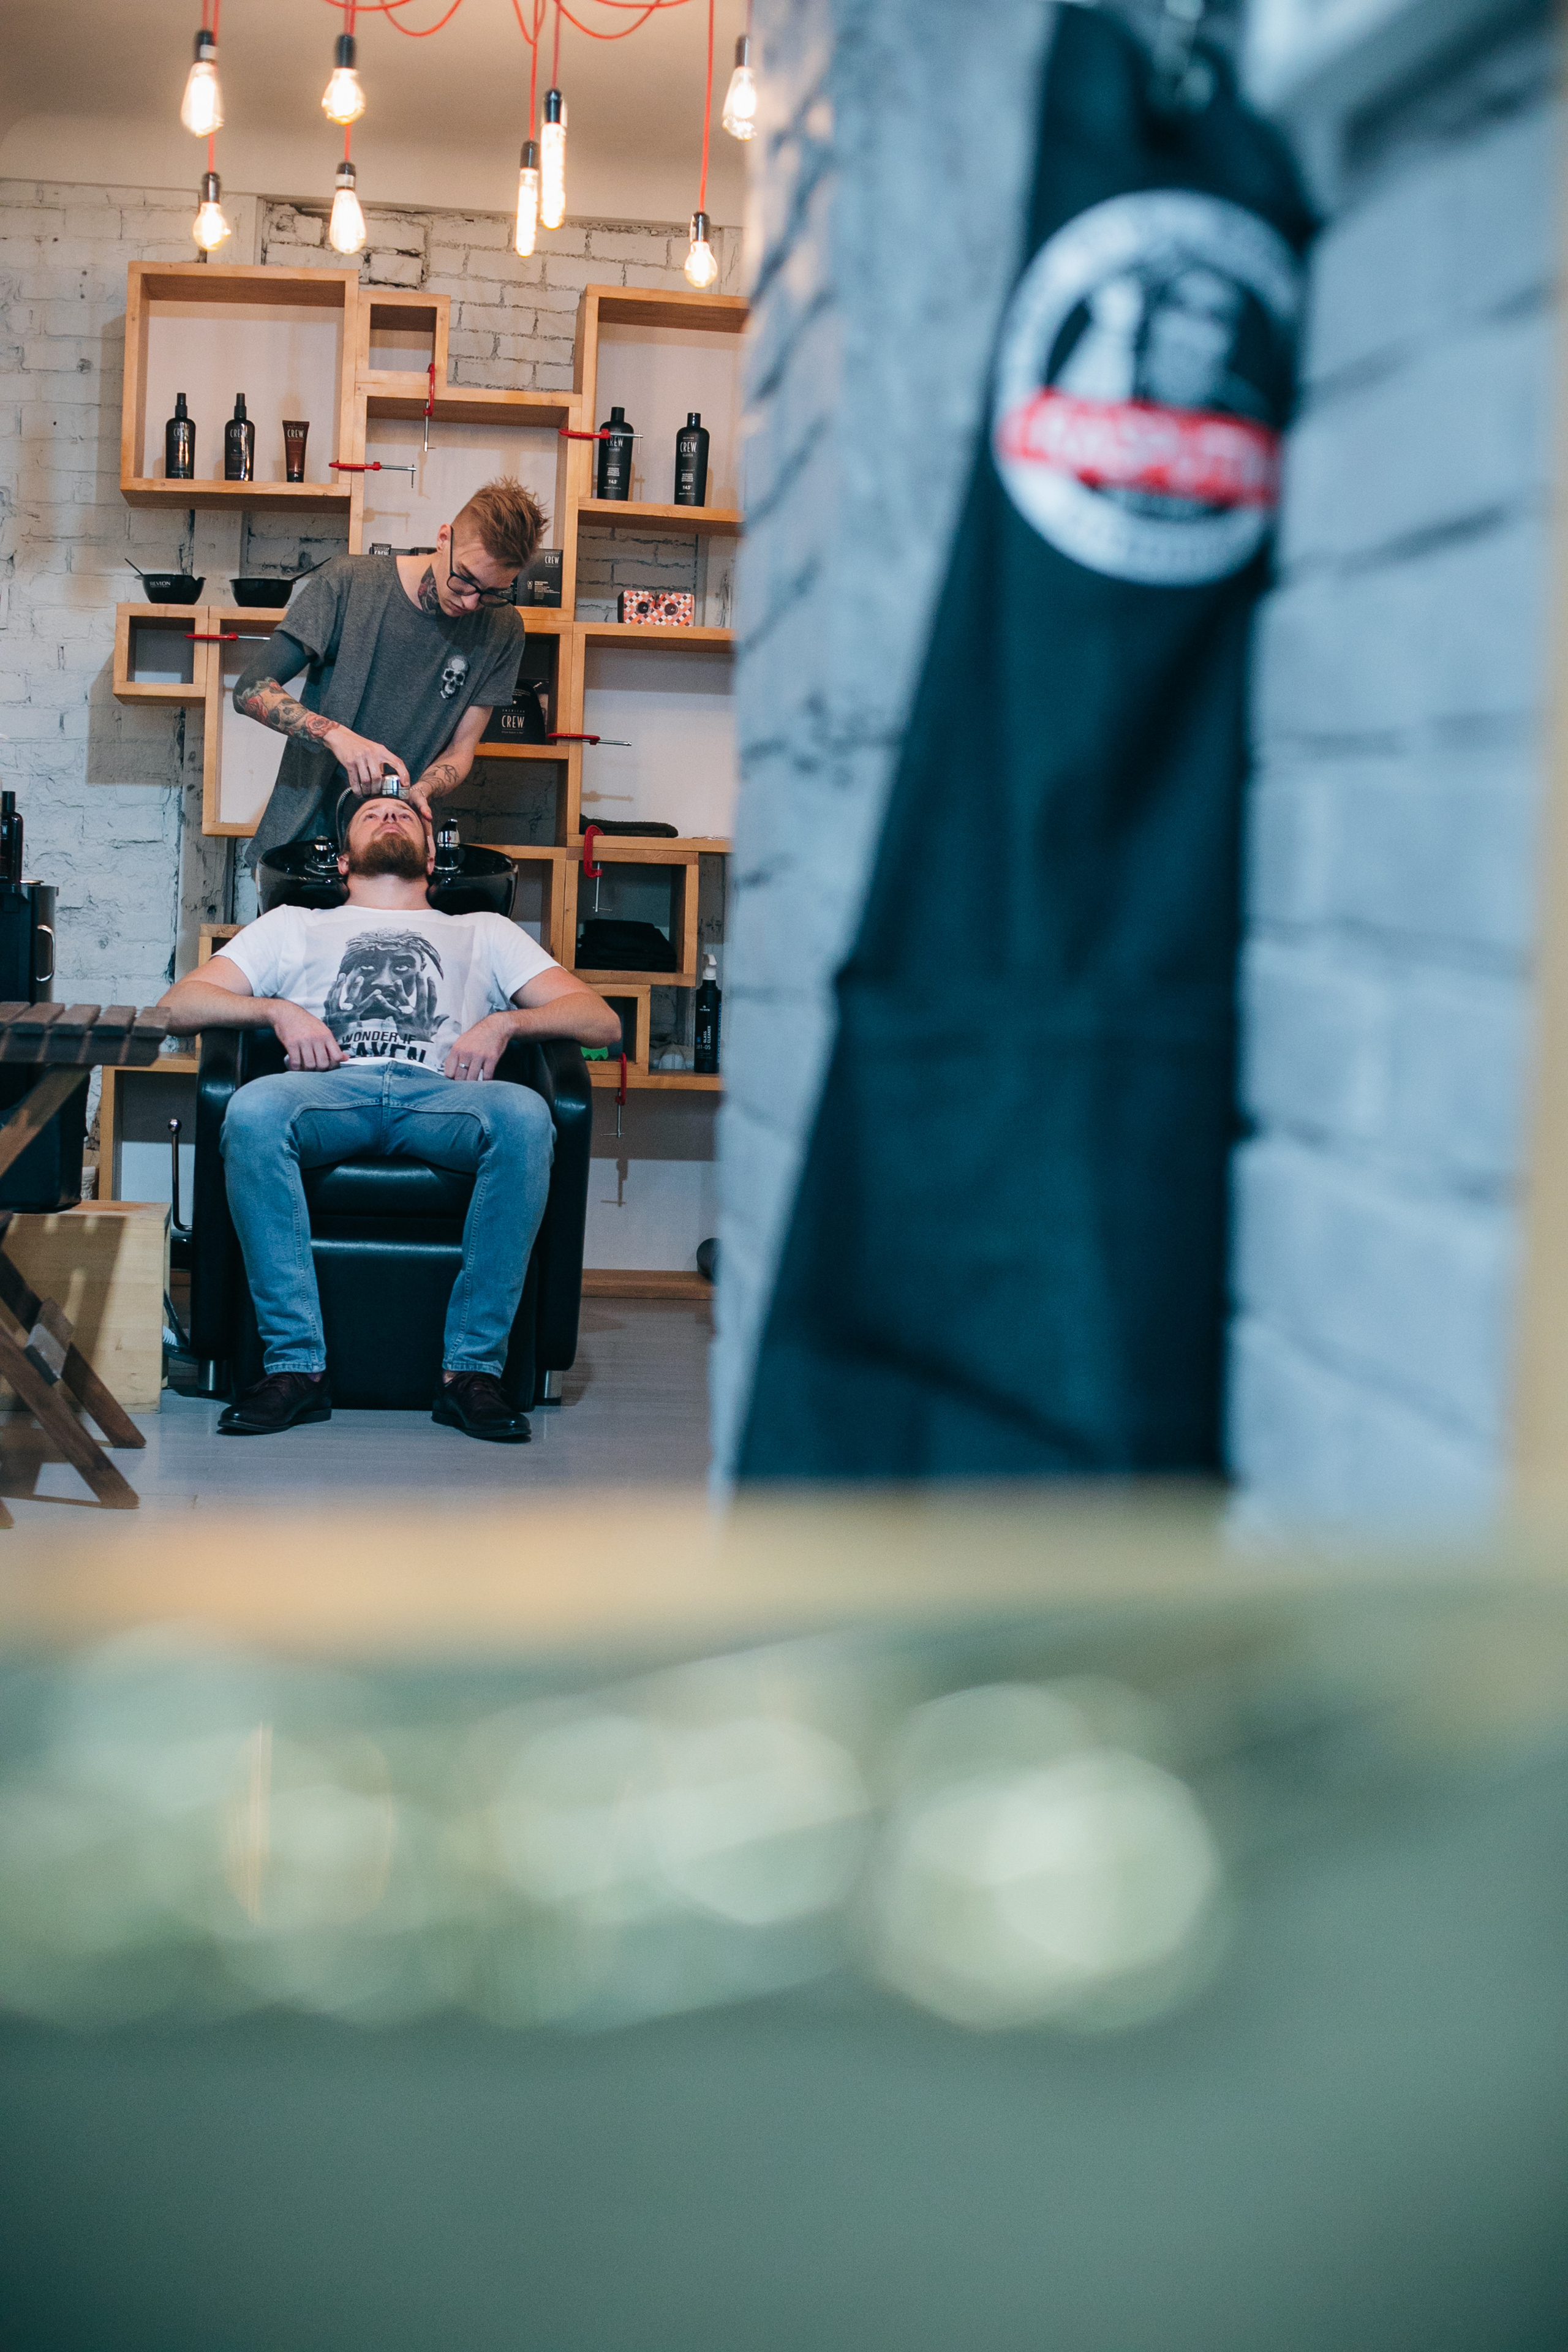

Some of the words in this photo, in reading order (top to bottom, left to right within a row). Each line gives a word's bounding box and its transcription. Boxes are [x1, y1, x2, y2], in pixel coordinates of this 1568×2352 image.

[173, 428, 189, 437] CREW
[287, 429, 304, 438] CREW
[606, 435, 624, 447] CREW
[680, 442, 697, 453] CREW
[545, 556, 560, 564] CREW
[501, 715, 525, 728] CREW
[342, 1031, 399, 1043] WONDER
[403, 1033, 417, 1044] IF
